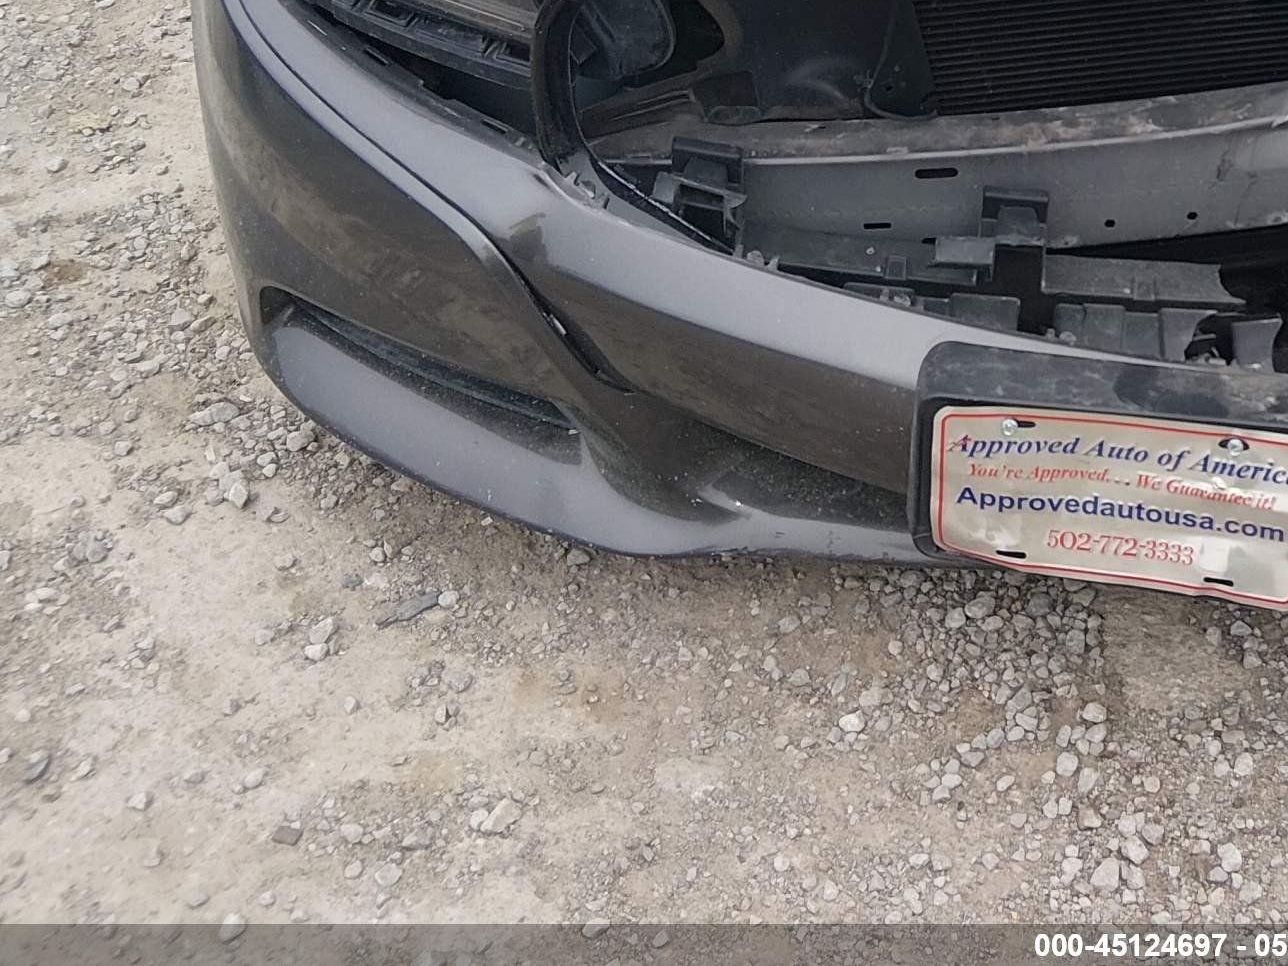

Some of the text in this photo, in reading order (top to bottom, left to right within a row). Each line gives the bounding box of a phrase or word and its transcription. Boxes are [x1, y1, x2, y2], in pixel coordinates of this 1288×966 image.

[947, 434, 1081, 459] Approved
[1083, 439, 1149, 463] Auto
[1157, 449, 1191, 472] of
[967, 463, 1024, 480] You're
[1135, 472, 1161, 491] We
[1165, 479, 1253, 508] Guarantee
[956, 486, 1285, 543] Approvedautousa.com
[1046, 528, 1196, 567] 502-772-3333
